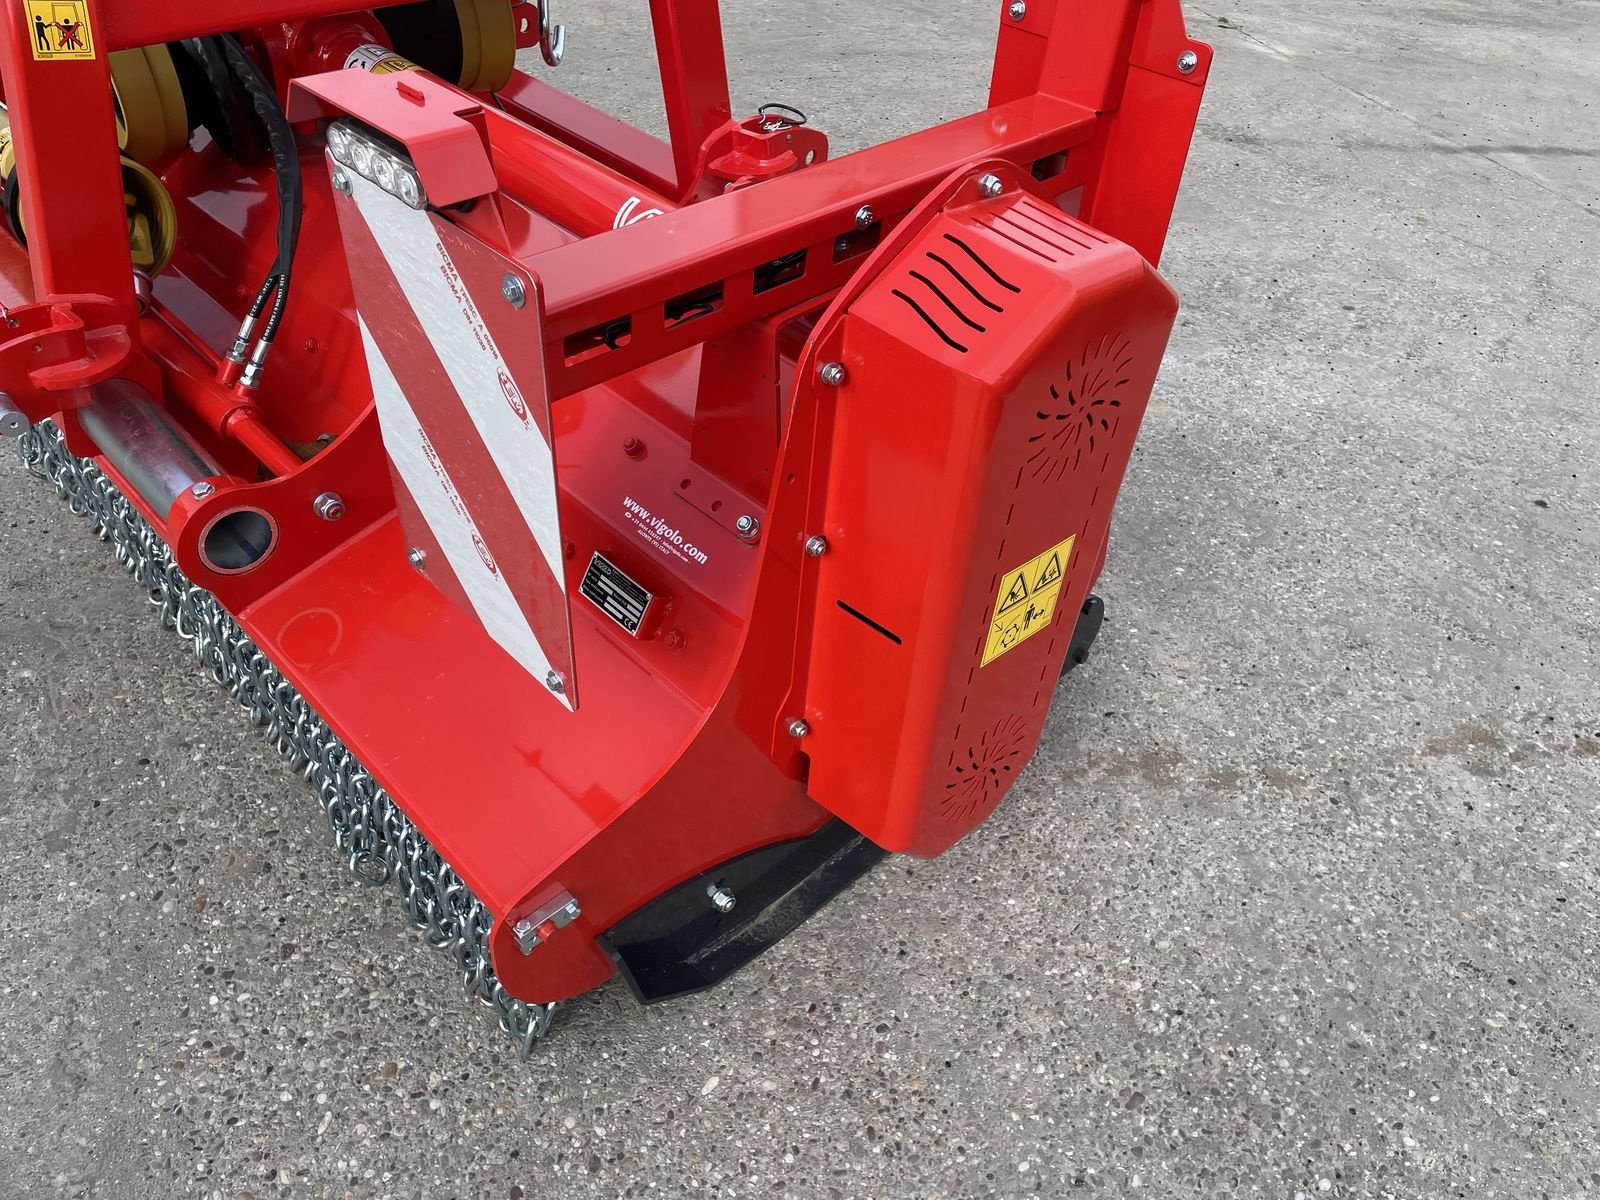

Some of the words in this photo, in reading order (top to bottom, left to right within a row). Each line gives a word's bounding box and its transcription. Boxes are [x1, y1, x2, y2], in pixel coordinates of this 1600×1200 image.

[436, 242, 458, 282] BICMA
[459, 286, 477, 318] TPESC
[440, 265, 462, 304] BICMA
[463, 308, 473, 325] DIN
[418, 428, 437, 460] BICMA
[421, 445, 440, 477] BICMA
[623, 496, 708, 565] www.vigolo.com
